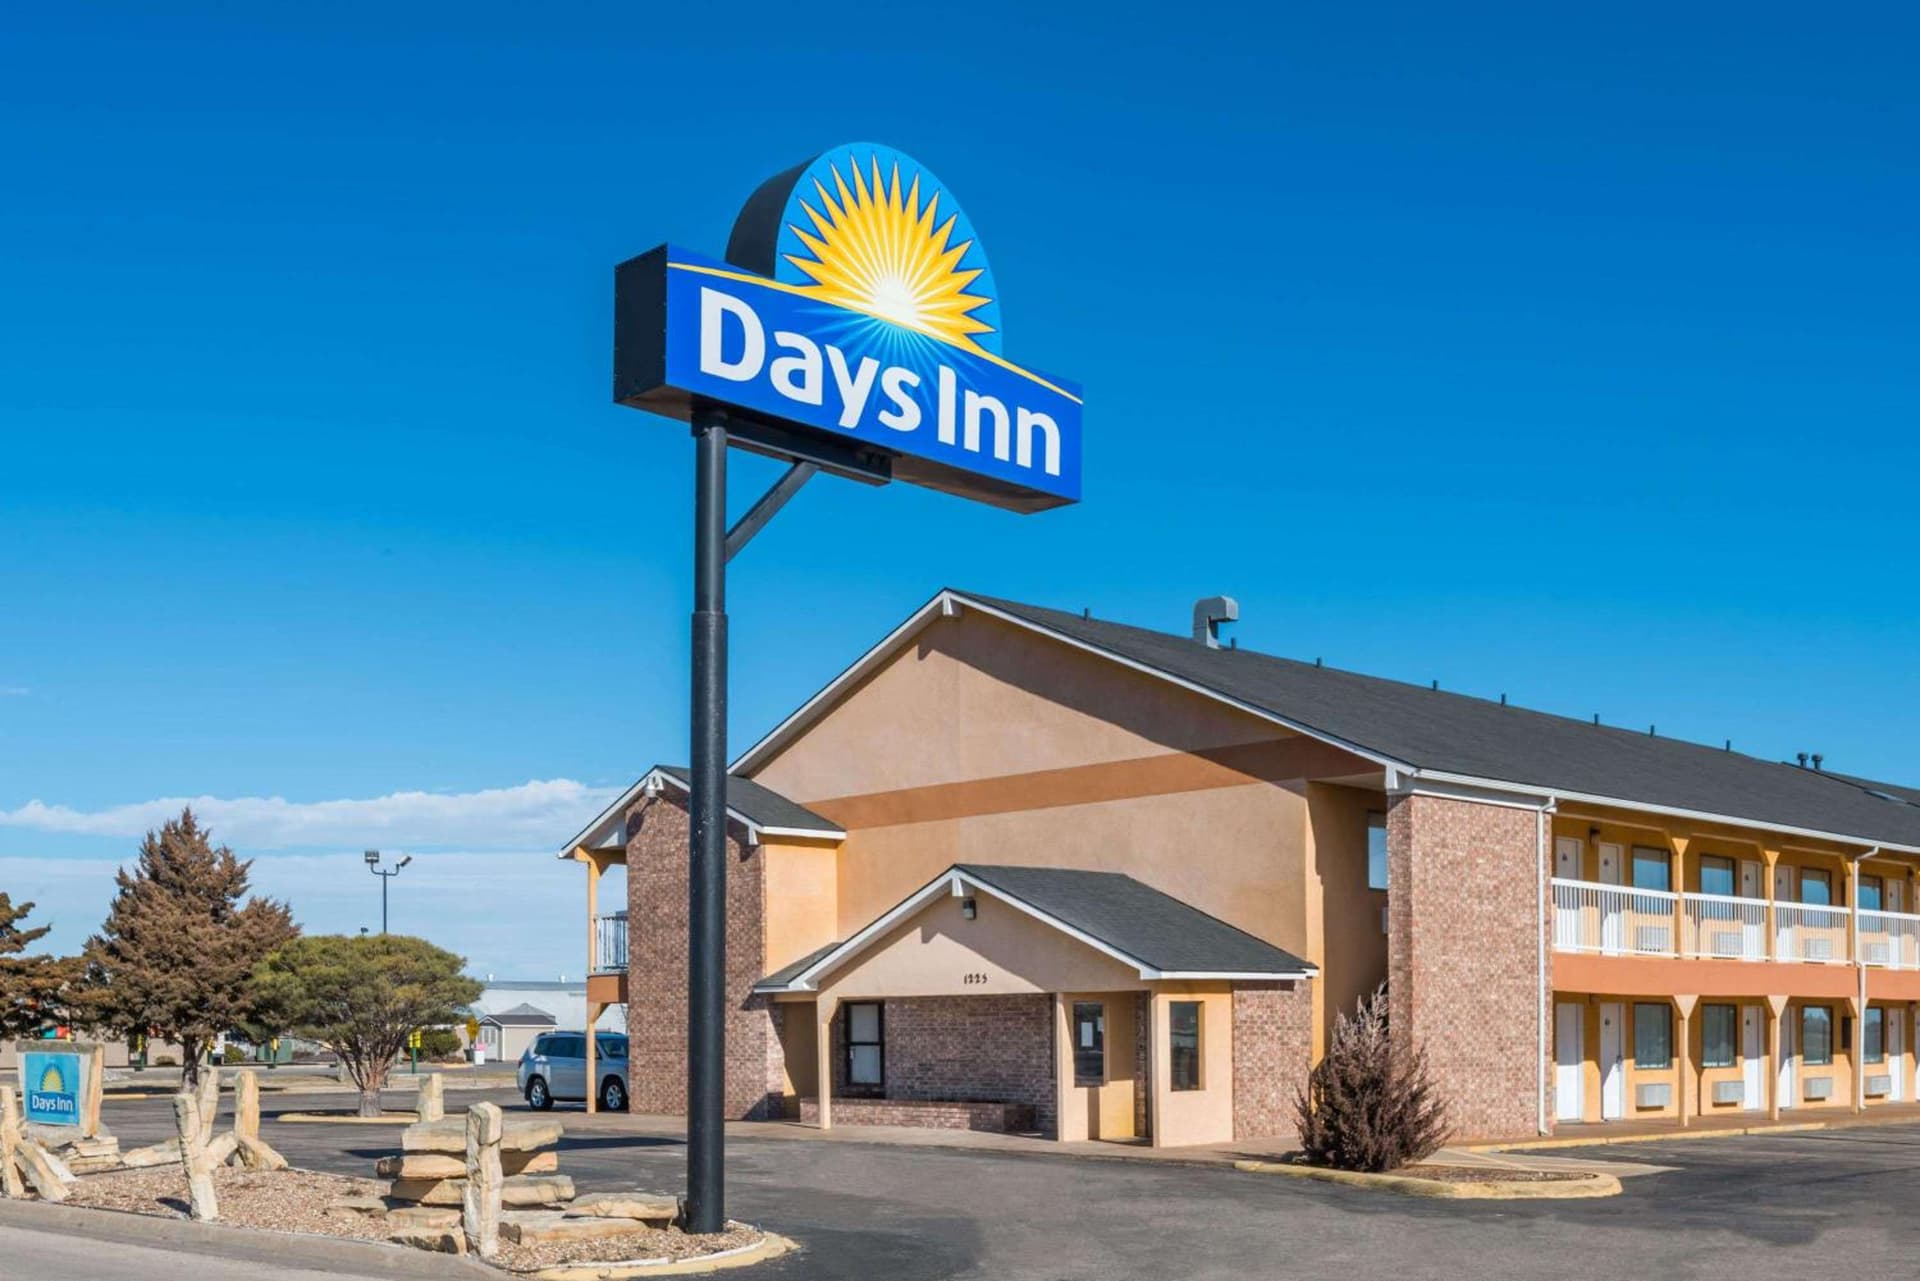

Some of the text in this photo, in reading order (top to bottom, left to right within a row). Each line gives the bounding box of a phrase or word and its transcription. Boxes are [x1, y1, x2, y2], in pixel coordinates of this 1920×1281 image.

[700, 286, 1061, 477] Days Inn
[31, 1095, 73, 1112] Days Inn
